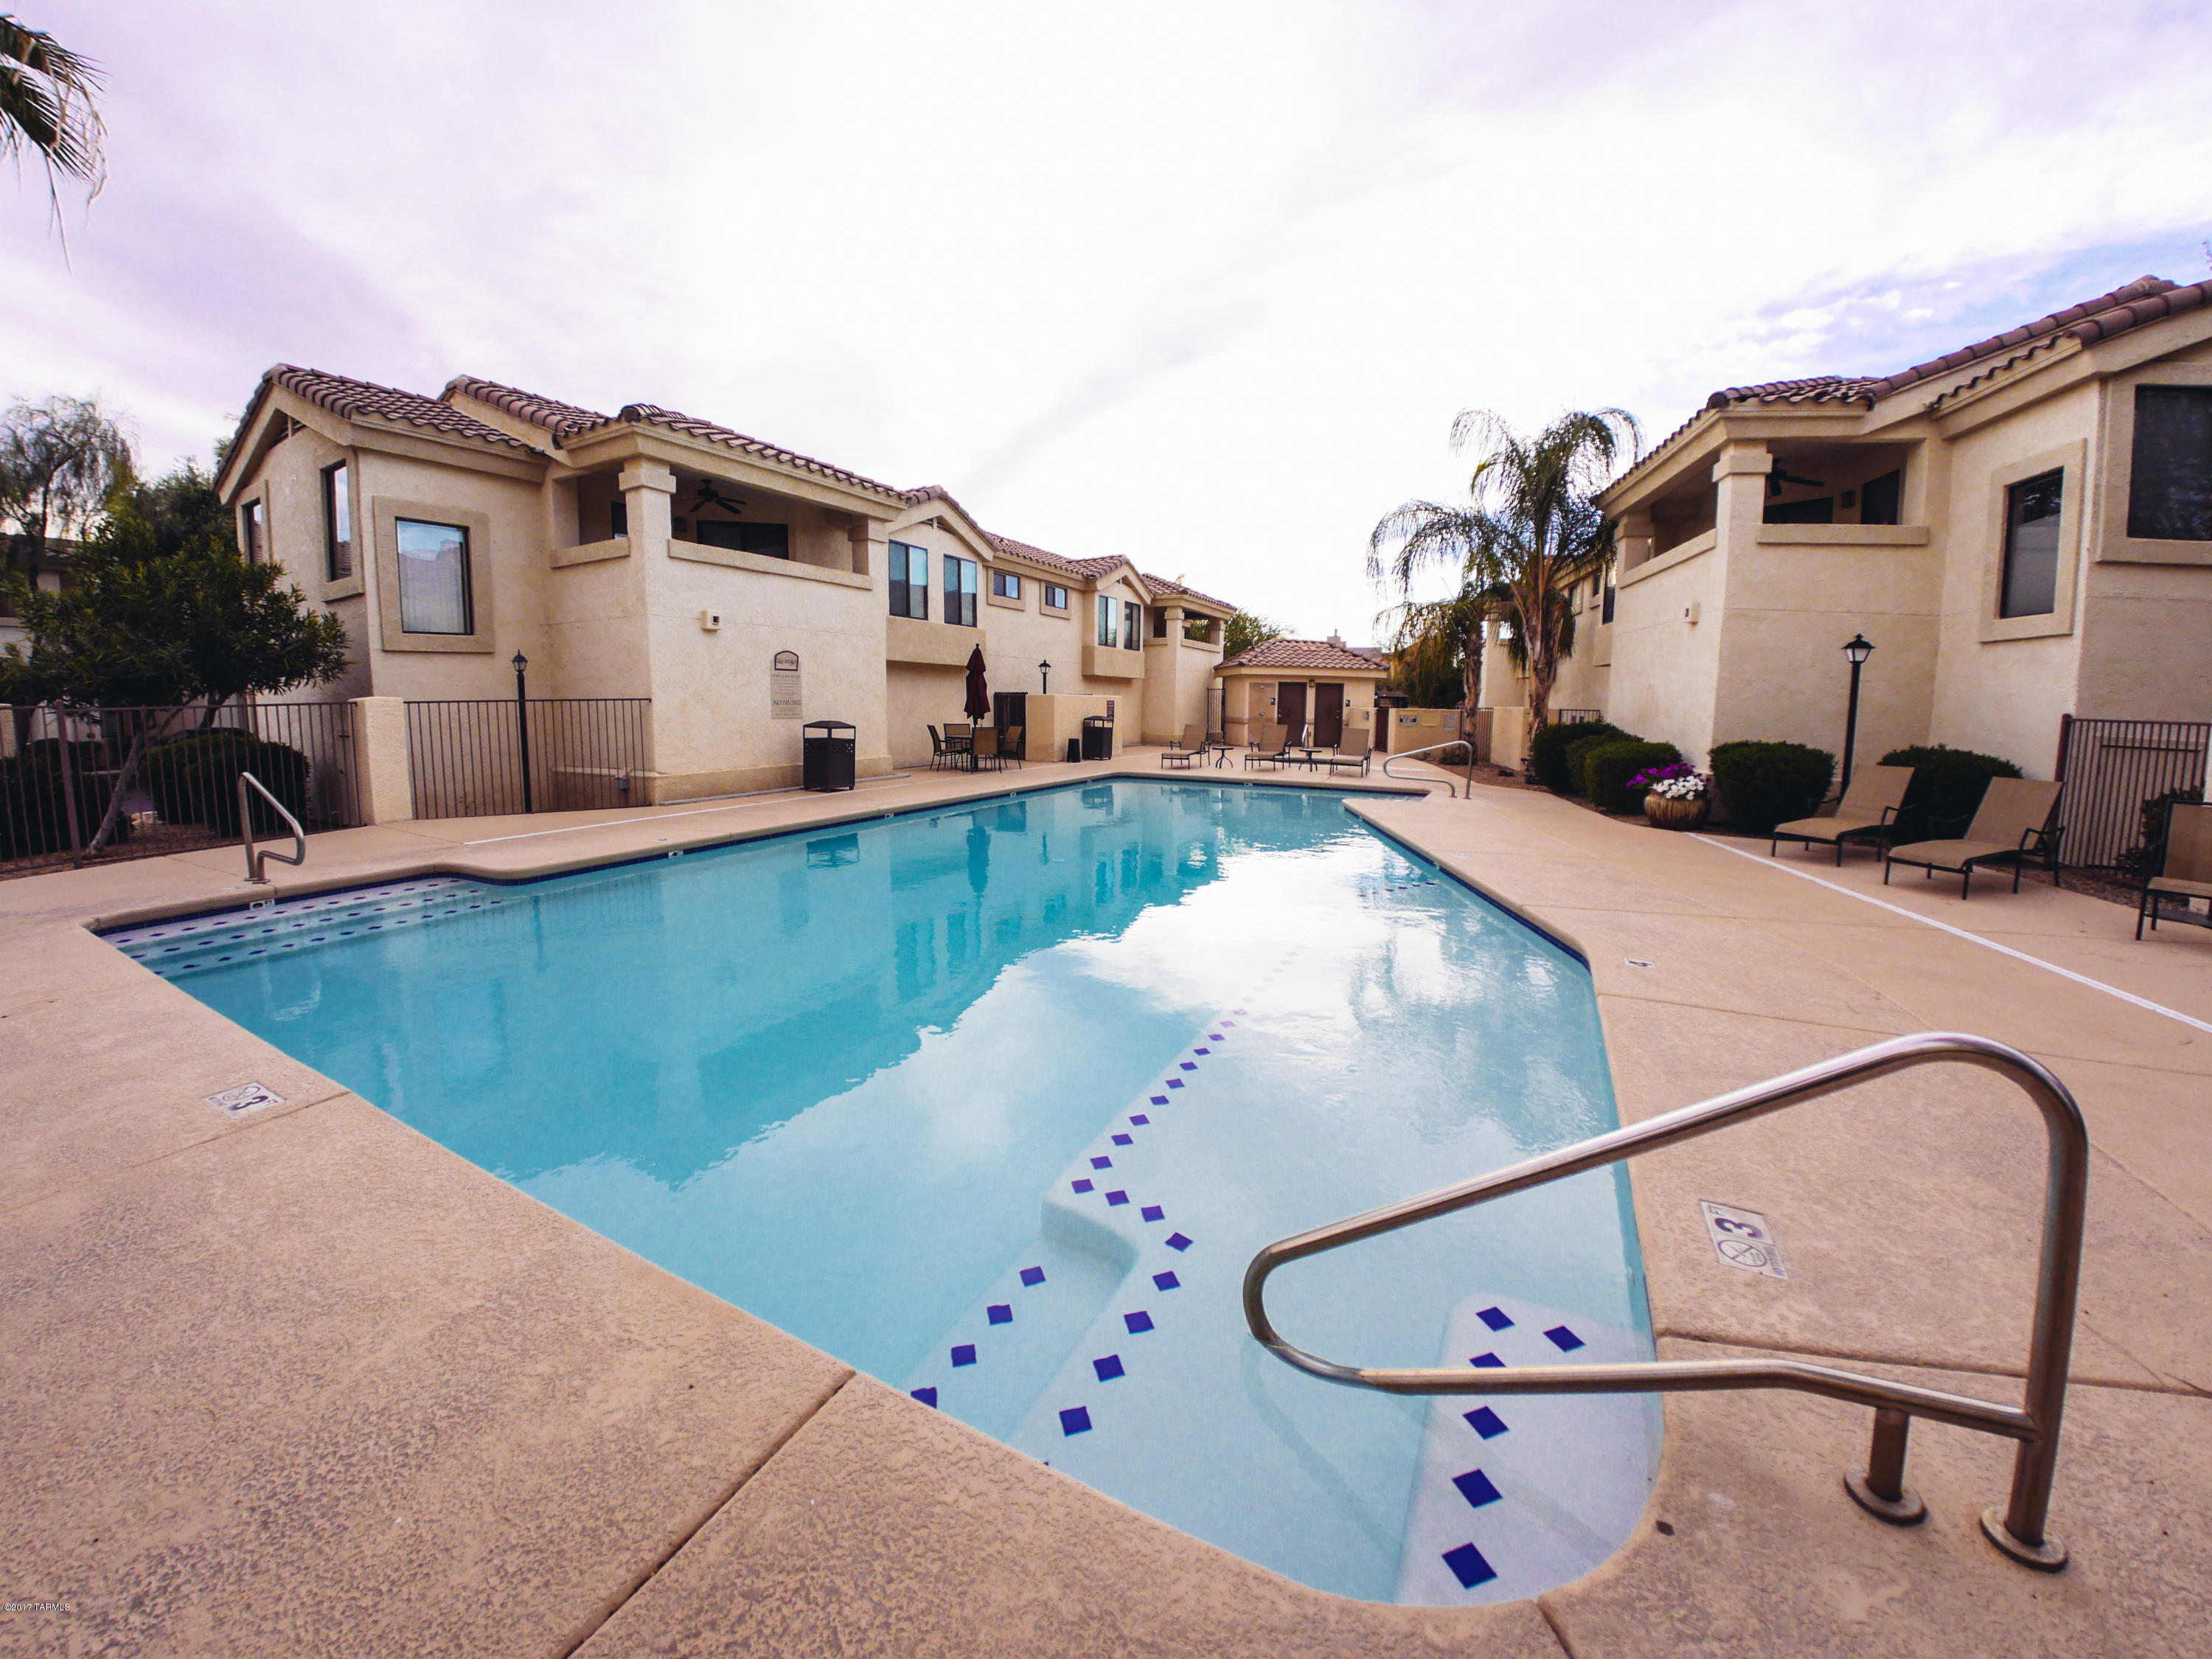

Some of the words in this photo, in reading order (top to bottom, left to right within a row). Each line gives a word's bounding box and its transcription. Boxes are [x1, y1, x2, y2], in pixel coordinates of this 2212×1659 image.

[229, 1096, 268, 1110] 3
[1708, 1204, 1725, 1217] FT
[1714, 1217, 1764, 1239] 3
